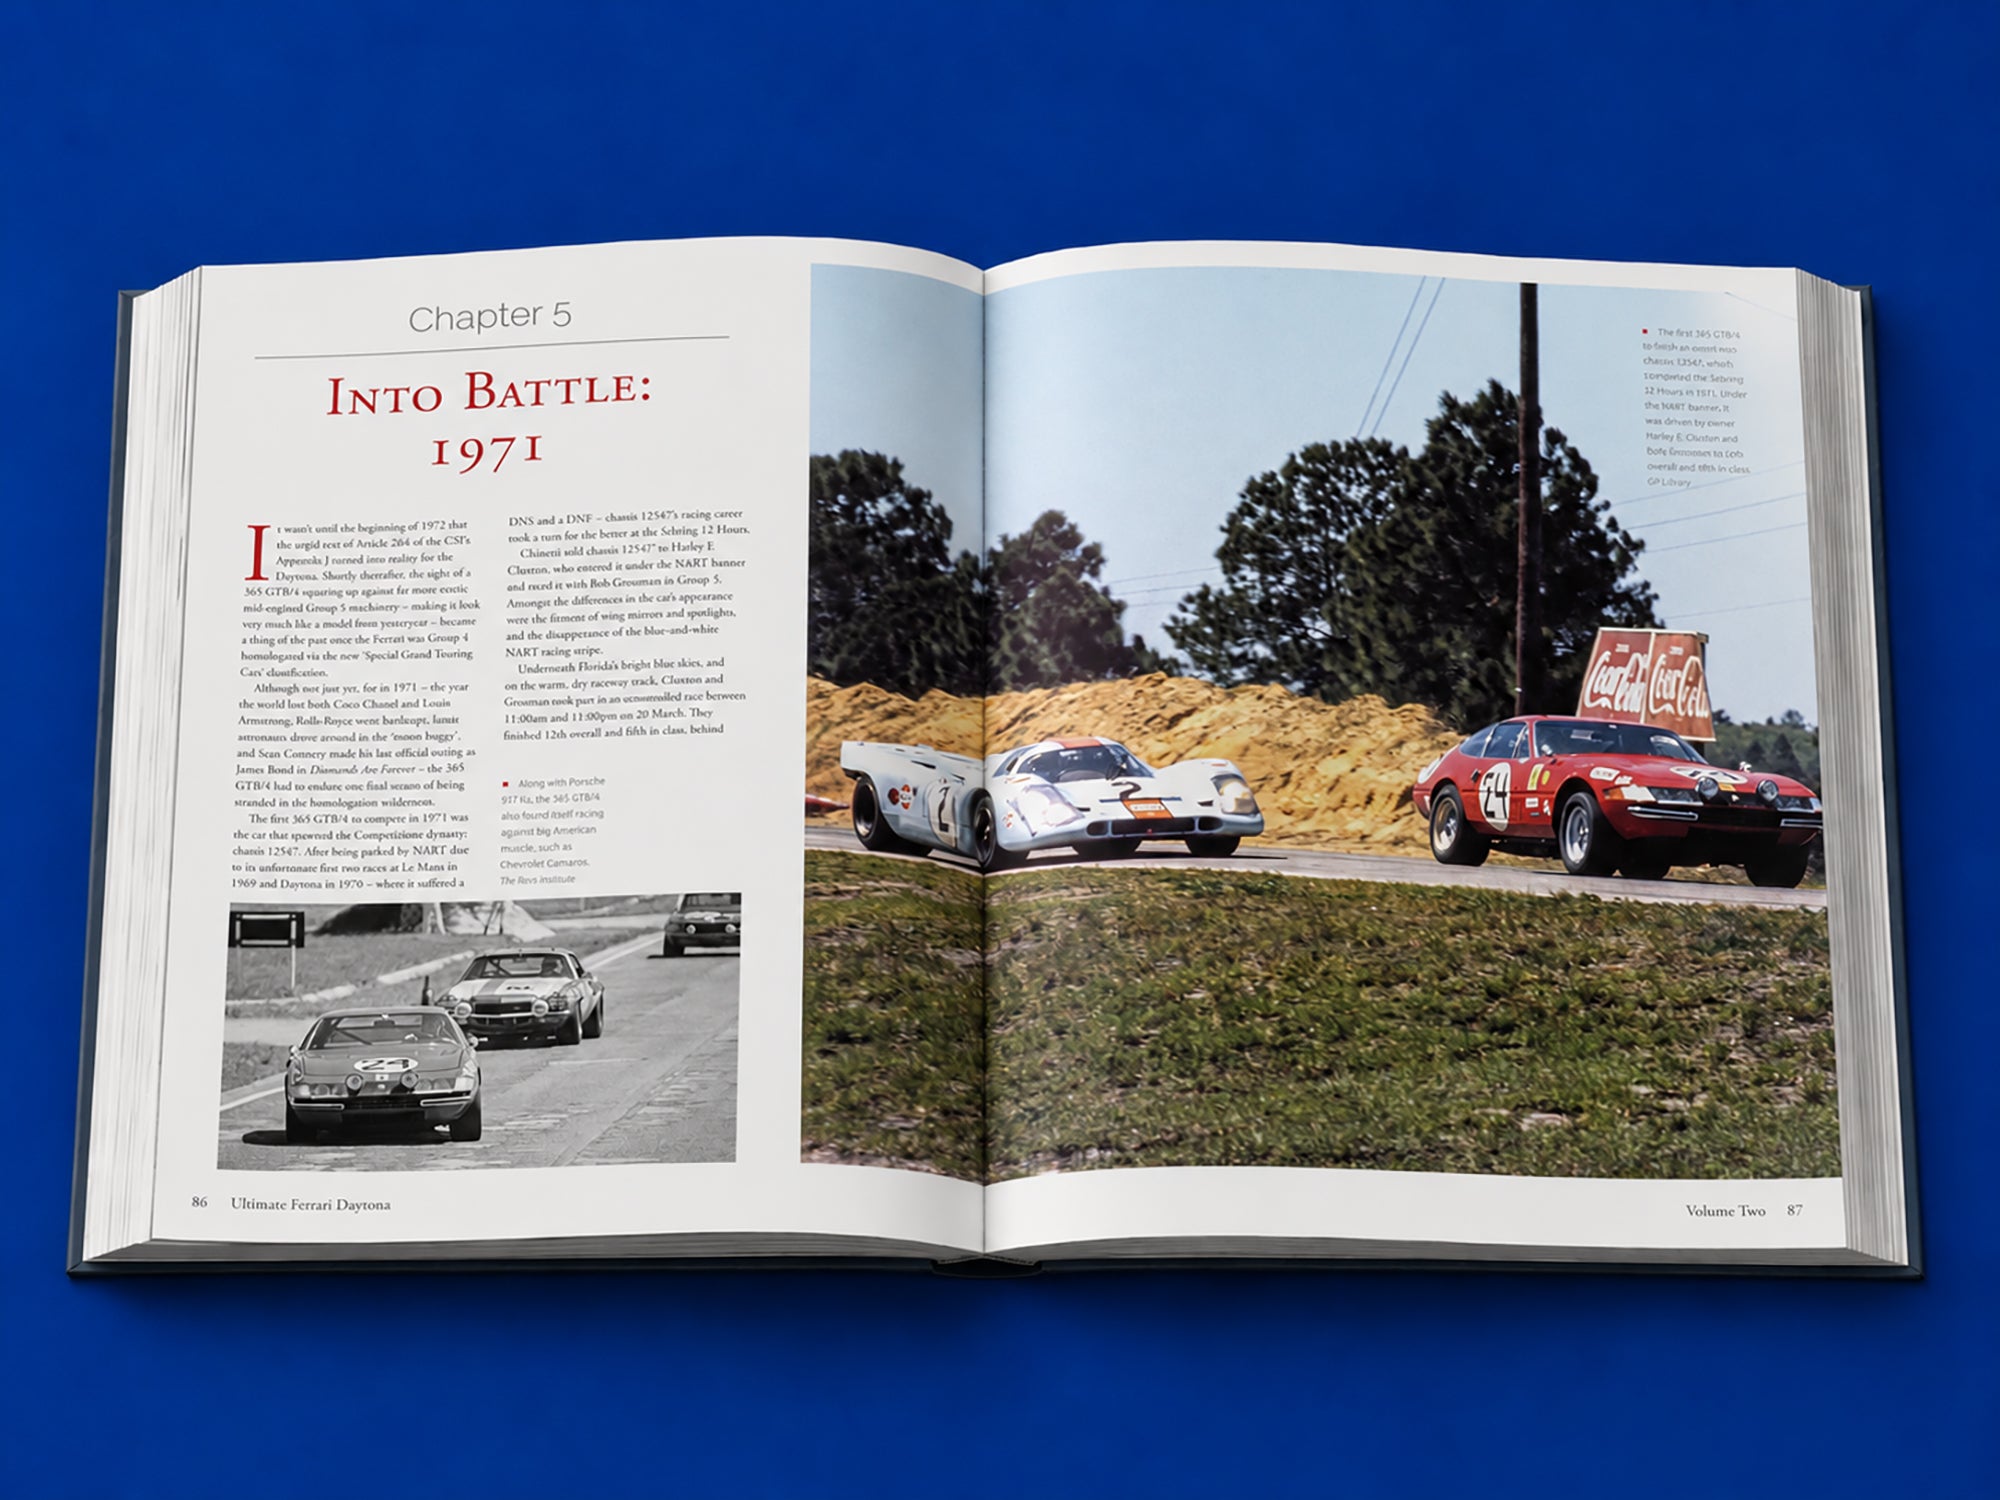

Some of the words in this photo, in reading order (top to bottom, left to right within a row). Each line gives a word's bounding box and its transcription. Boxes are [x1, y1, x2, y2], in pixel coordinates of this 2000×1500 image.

[409, 303, 543, 335] Chapter
[552, 302, 572, 327] 5
[431, 435, 543, 475] 1971
[422, 520, 446, 531] 1972
[448, 519, 468, 530] that
[508, 515, 535, 527] DNS
[536, 515, 556, 526] and
[580, 528, 598, 540] the
[701, 524, 714, 535] 12
[304, 602, 339, 616] Group
[458, 598, 481, 610] look
[665, 607, 685, 618] and
[426, 632, 461, 646] Group
[505, 629, 525, 641] and
[625, 625, 642, 637] the
[400, 648, 433, 660] Grand
[505, 646, 540, 658] NART
[540, 645, 572, 659] racing
[706, 656, 725, 667] and
[704, 673, 724, 684] and
[393, 681, 417, 693] 1971
[400, 697, 420, 709] and
[549, 711, 569, 723] and
[545, 728, 567, 740] 12th
[604, 726, 624, 737] and
[689, 722, 724, 734] behind
[236, 747, 256, 758] and
[267, 763, 295, 775] Bond
[568, 776, 606, 787] Porsche
[291, 795, 308, 808] the
[248, 812, 269, 824] The
[450, 814, 469, 822] was
[535, 826, 552, 838] big
[232, 878, 257, 888] 1969
[258, 877, 278, 889] and
[280, 878, 323, 891] Daytona
[338, 878, 364, 889] 1970
[191, 1196, 208, 1208] 86
[231, 1198, 288, 1210] Ultimate
[290, 1198, 333, 1211] Ferrari
[336, 1199, 391, 1214] Daytona
[1686, 1204, 1736, 1217] Volume
[1737, 1204, 1767, 1217] Two
[1786, 1204, 1803, 1216] 87
